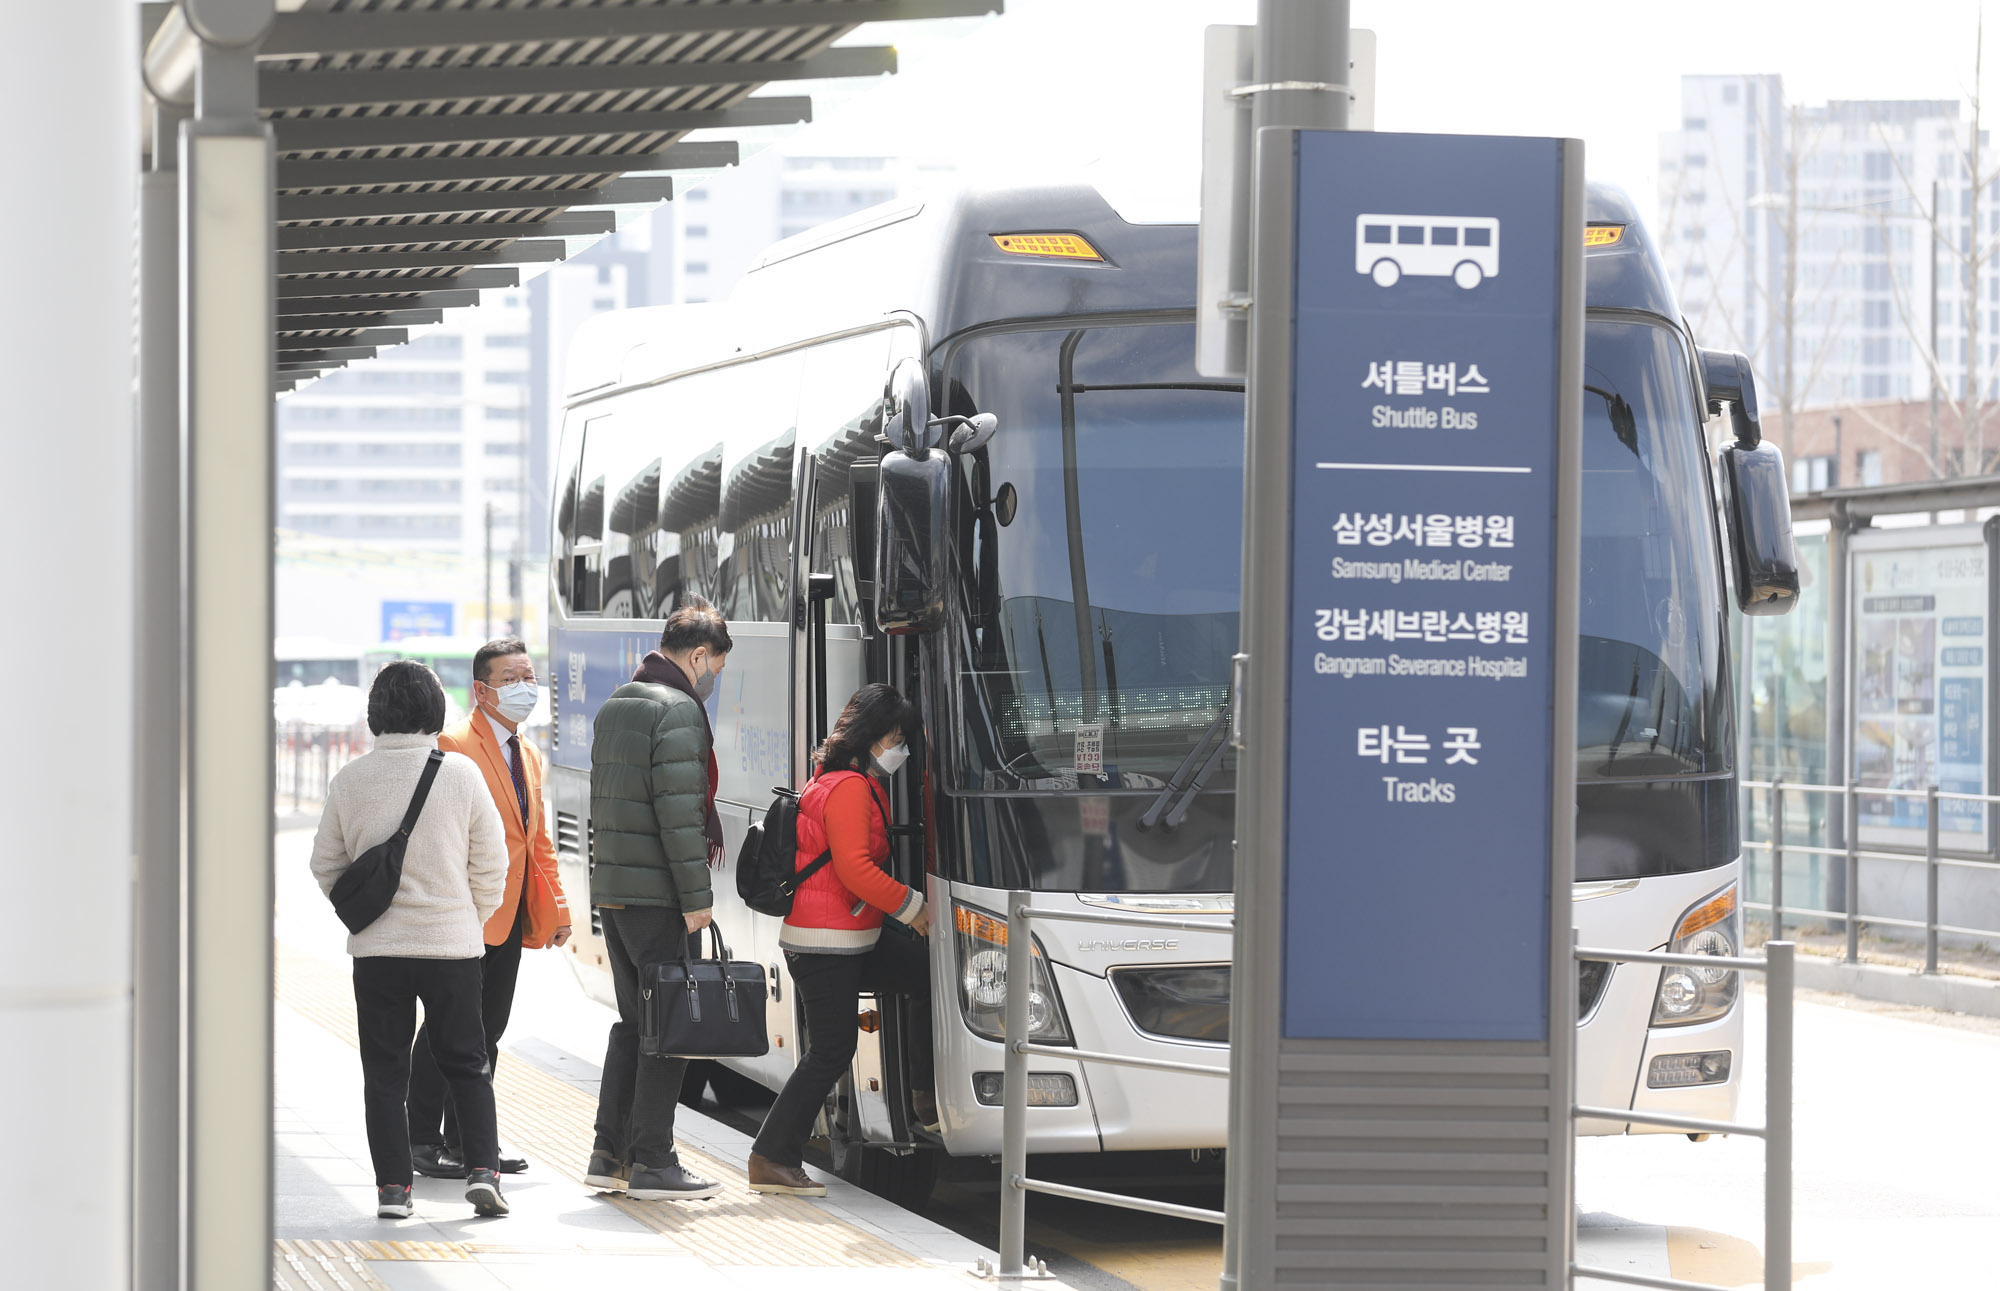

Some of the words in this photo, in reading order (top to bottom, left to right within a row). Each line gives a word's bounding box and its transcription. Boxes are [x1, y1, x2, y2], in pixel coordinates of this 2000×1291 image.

[1361, 360, 1490, 396] 셔틀버스
[1372, 405, 1438, 429] Shuttle
[1441, 406, 1478, 430] Bus
[1332, 512, 1514, 548] 삼성서울병원
[1332, 556, 1401, 584] Samsung
[1404, 559, 1461, 581] Medical
[1463, 560, 1512, 581] Center
[1314, 608, 1529, 644] 강남세브란스병원
[1314, 652, 1386, 679] Gangnam
[1388, 654, 1466, 677] Severance
[1468, 656, 1527, 681] Hospital
[1003, 688, 1232, 736] 삼성서울병
[1357, 725, 1431, 764] 타는
[1442, 727, 1481, 765] 곳
[1382, 777, 1456, 803] Tracks
[1078, 938, 1180, 952] UNIVERSE
